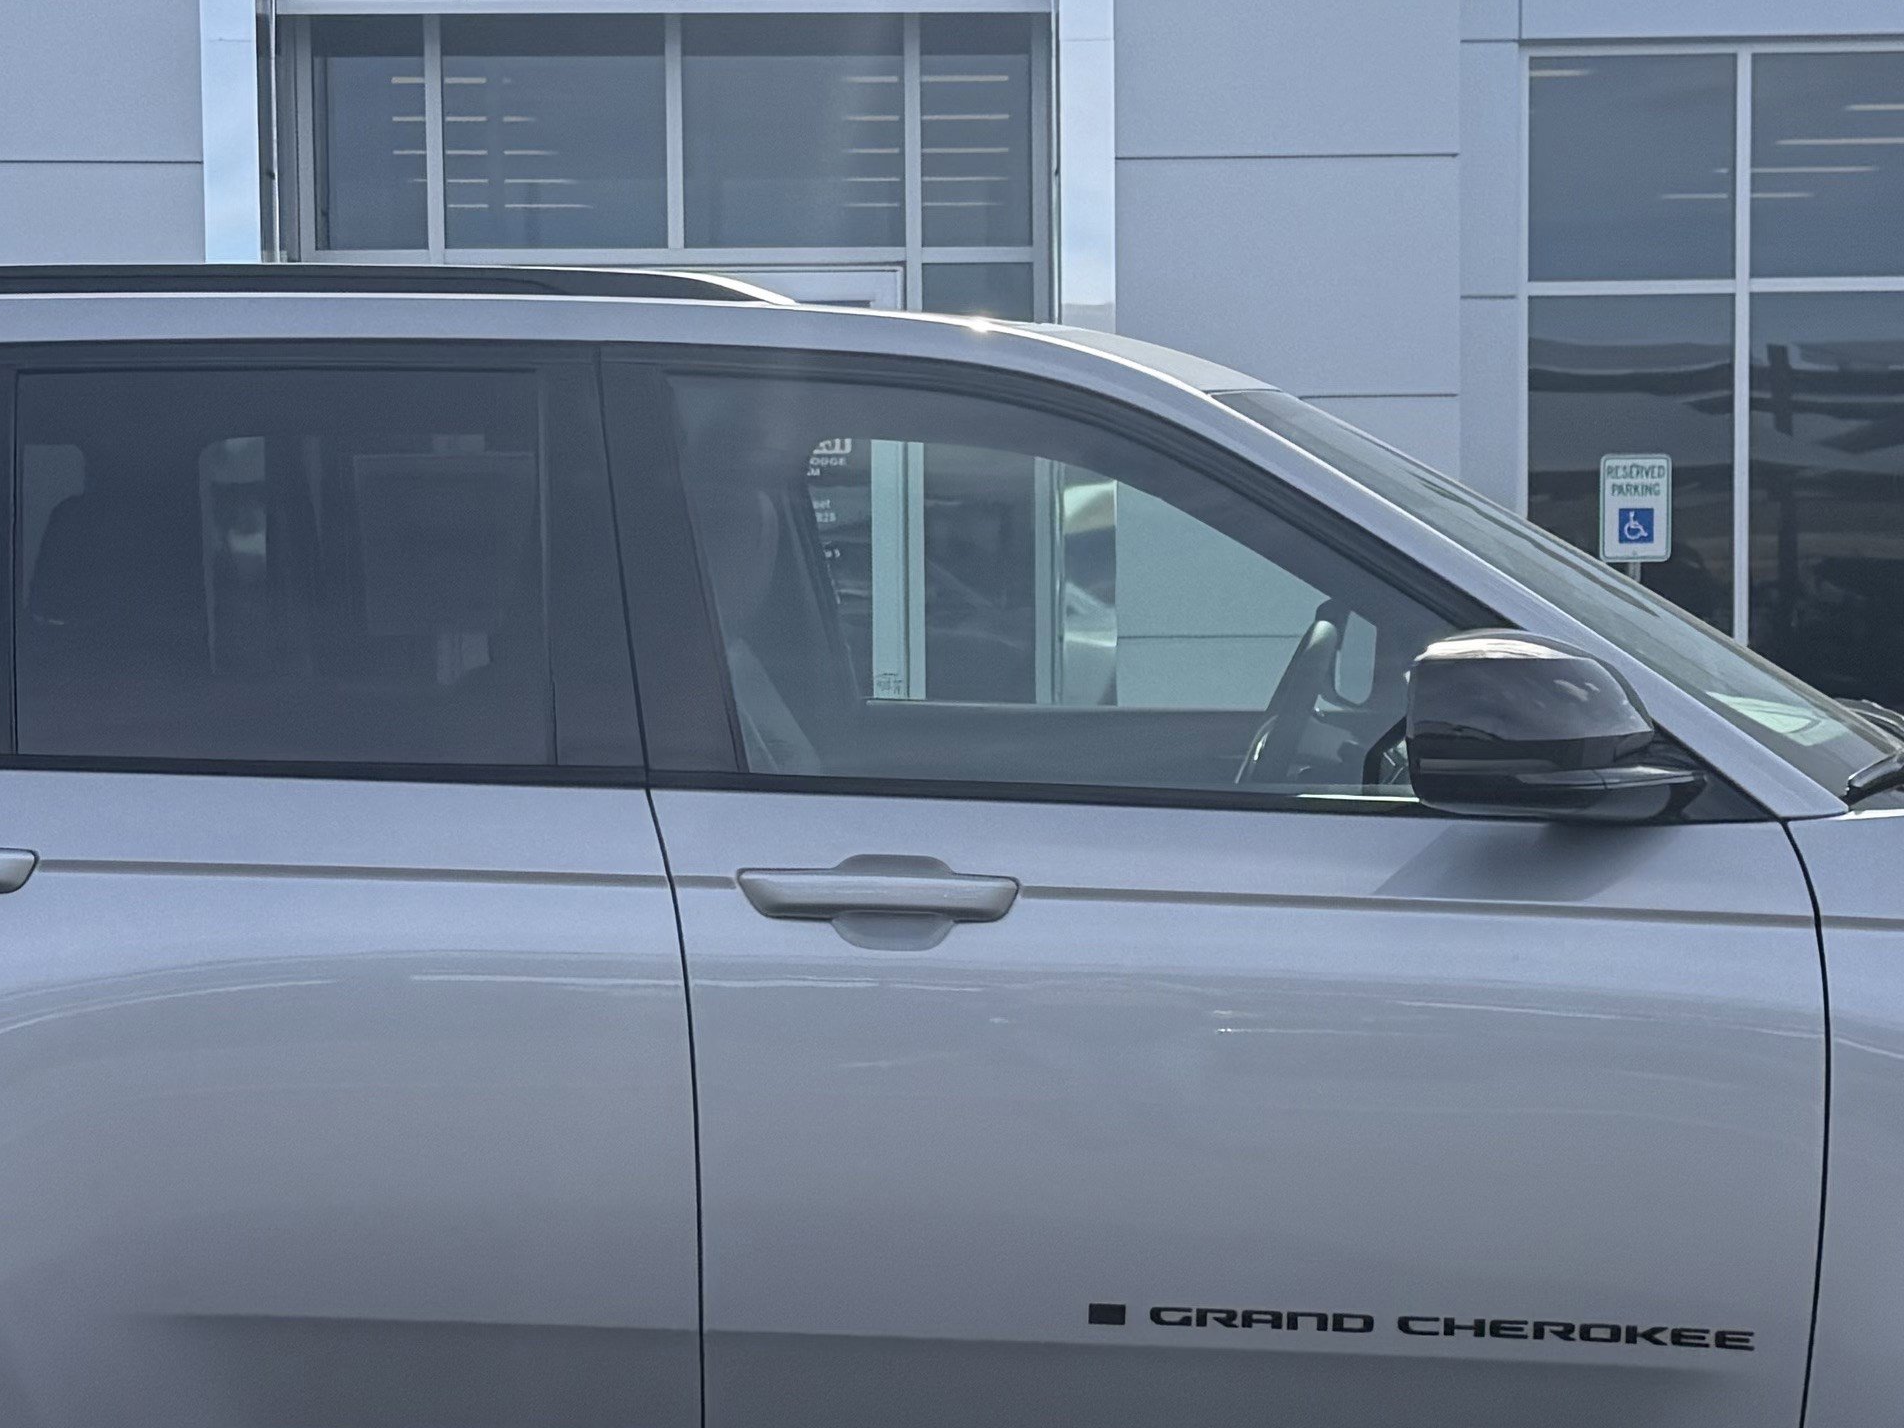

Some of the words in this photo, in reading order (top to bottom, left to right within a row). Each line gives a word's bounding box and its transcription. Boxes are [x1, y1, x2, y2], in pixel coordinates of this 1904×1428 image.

[1606, 464, 1666, 480] RESERVED
[1611, 483, 1661, 497] PARKING
[1148, 1305, 1375, 1335] GRAND
[1396, 1315, 1756, 1351] CHEROKEE
